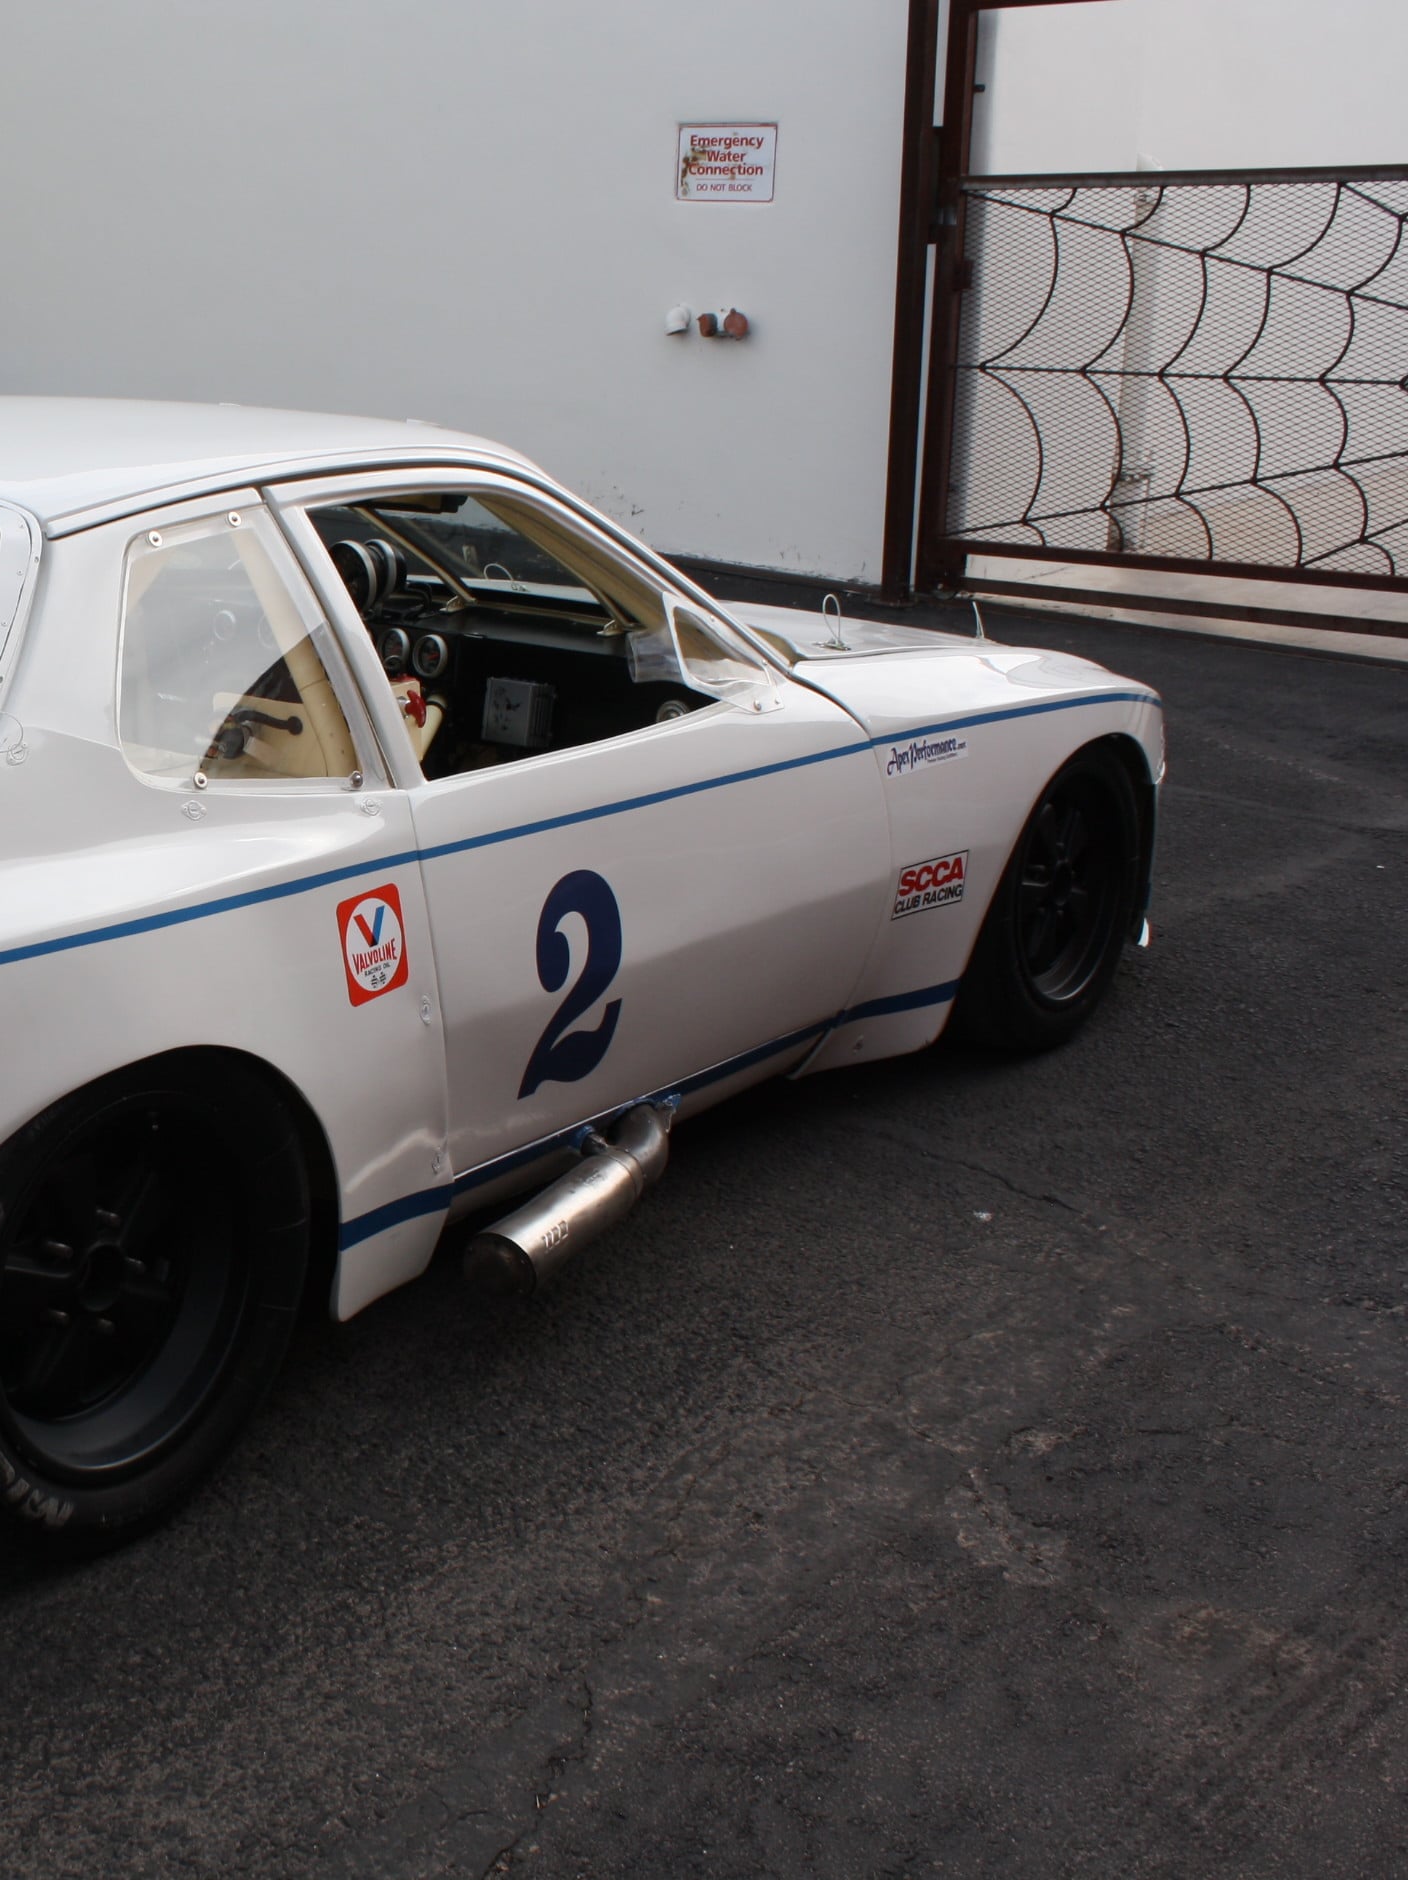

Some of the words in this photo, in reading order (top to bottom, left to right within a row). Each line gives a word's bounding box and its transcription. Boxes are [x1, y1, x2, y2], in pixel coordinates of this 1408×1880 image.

[689, 135, 764, 150] Emergency
[707, 150, 747, 162] Water
[688, 163, 764, 176] Connection
[696, 183, 708, 192] DO
[710, 183, 726, 192] NOT
[728, 184, 753, 192] BLOCK
[898, 856, 963, 897] SCCA
[894, 895, 921, 914] CLUB
[922, 884, 963, 906] RACING
[352, 938, 398, 976] VALVOLINE
[517, 869, 622, 1100] 2
